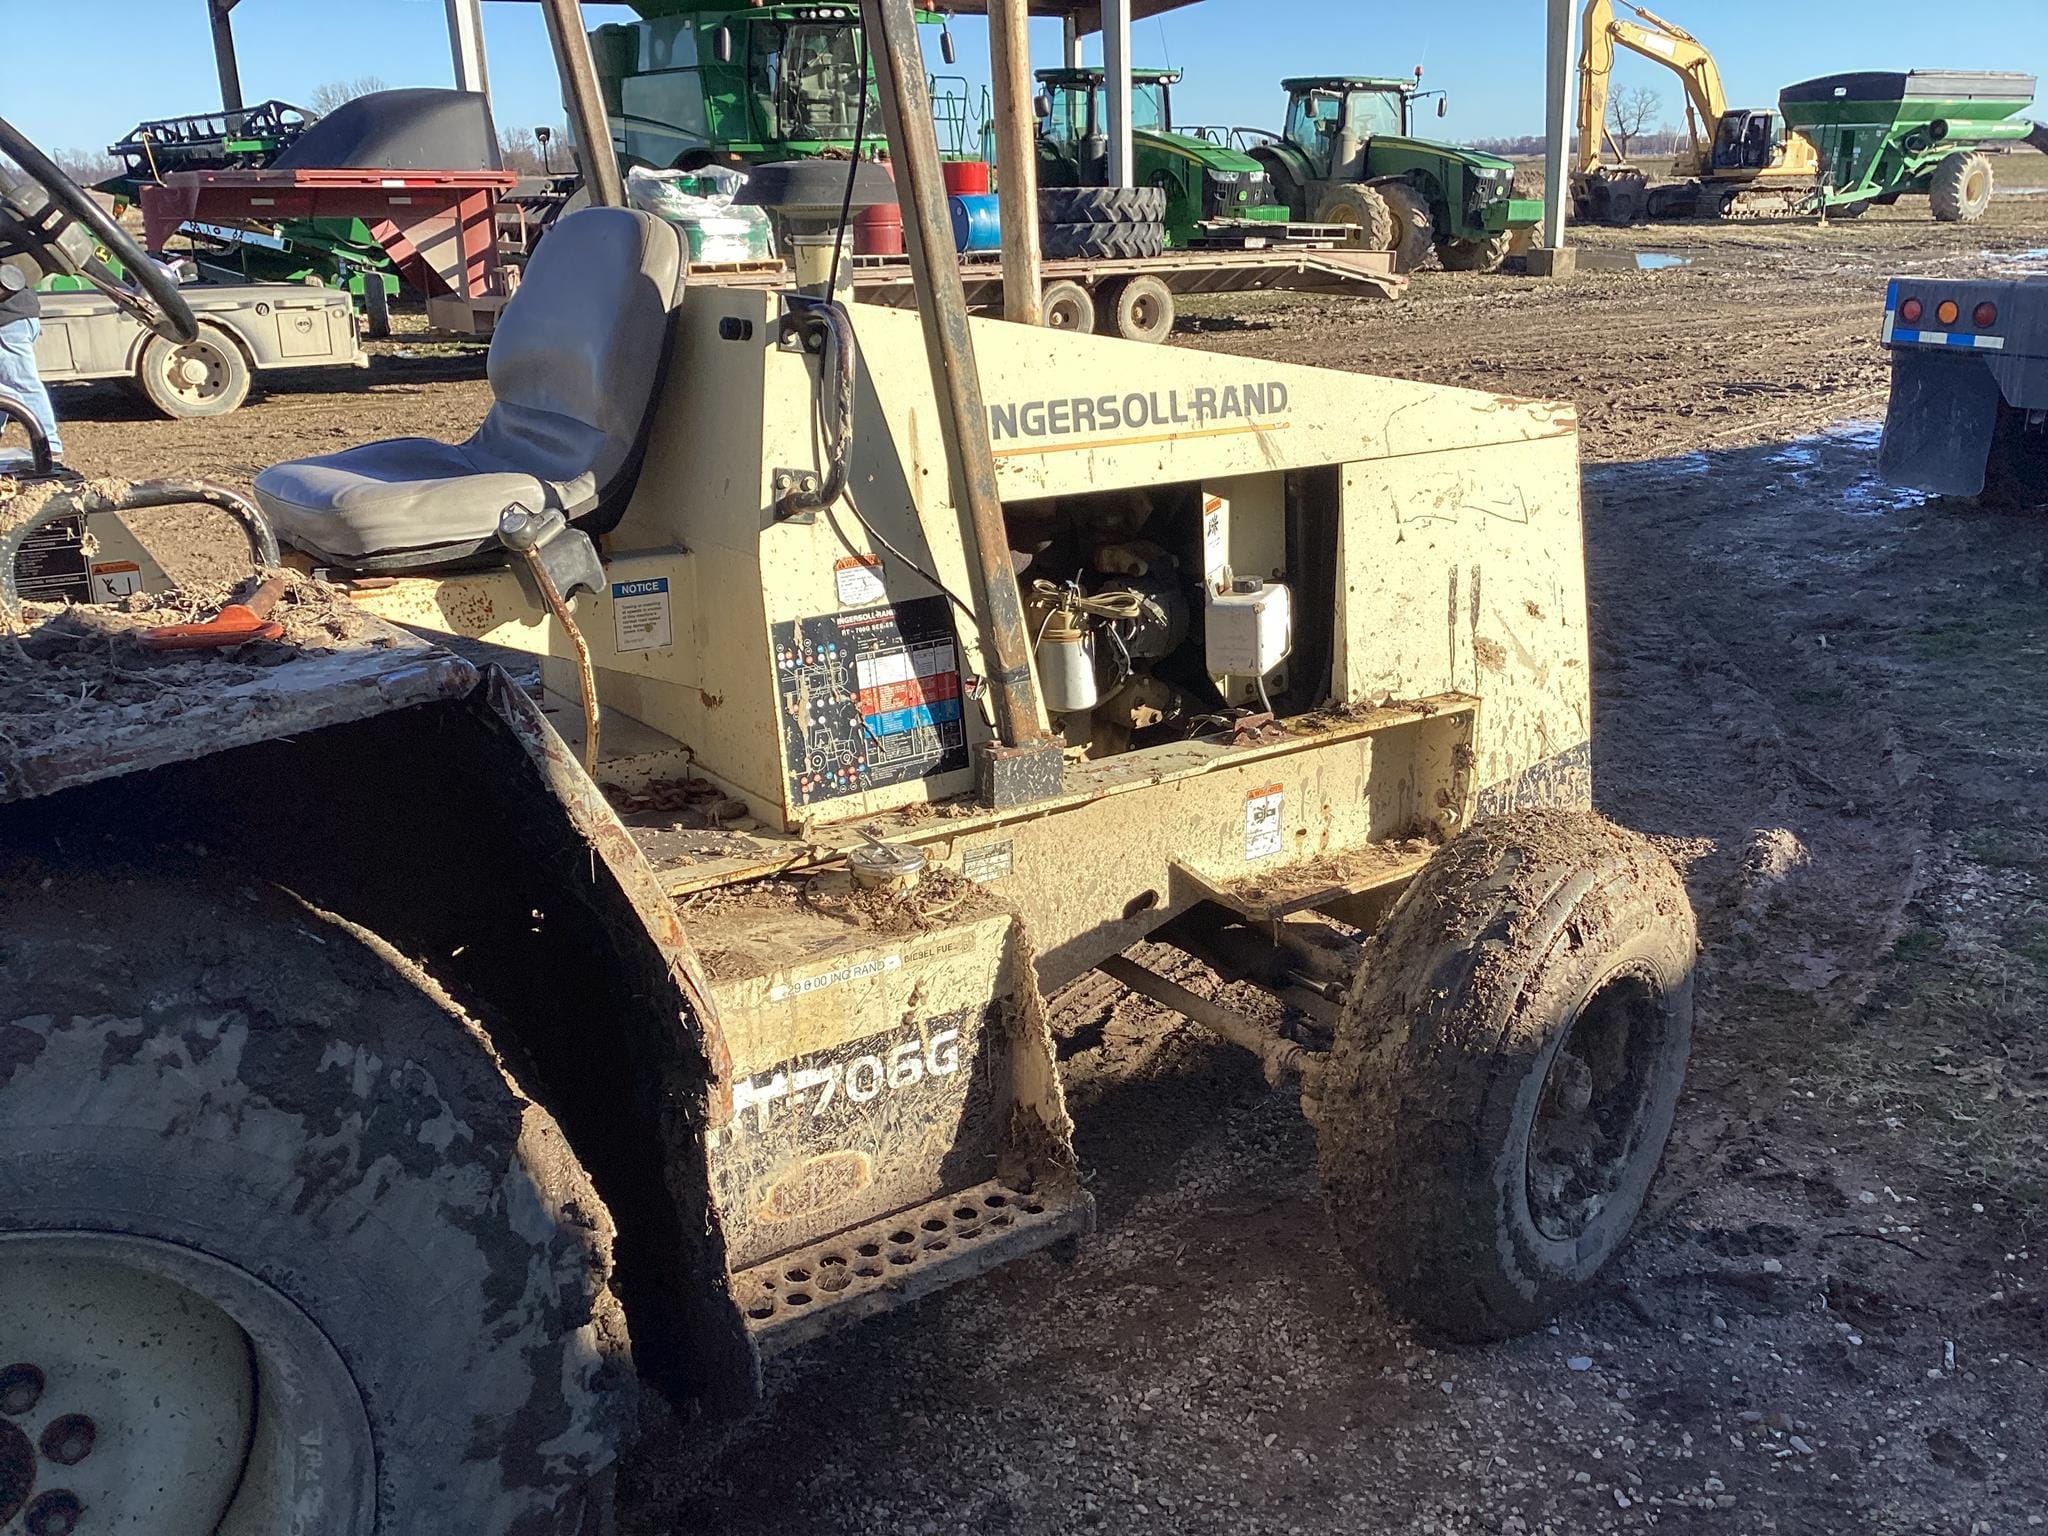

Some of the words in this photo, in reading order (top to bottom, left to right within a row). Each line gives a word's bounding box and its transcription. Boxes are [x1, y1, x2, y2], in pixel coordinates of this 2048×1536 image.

[984, 381, 1288, 440] NGERSOLL-RAND
[621, 581, 660, 594] NOTICE
[854, 960, 885, 977] RAND
